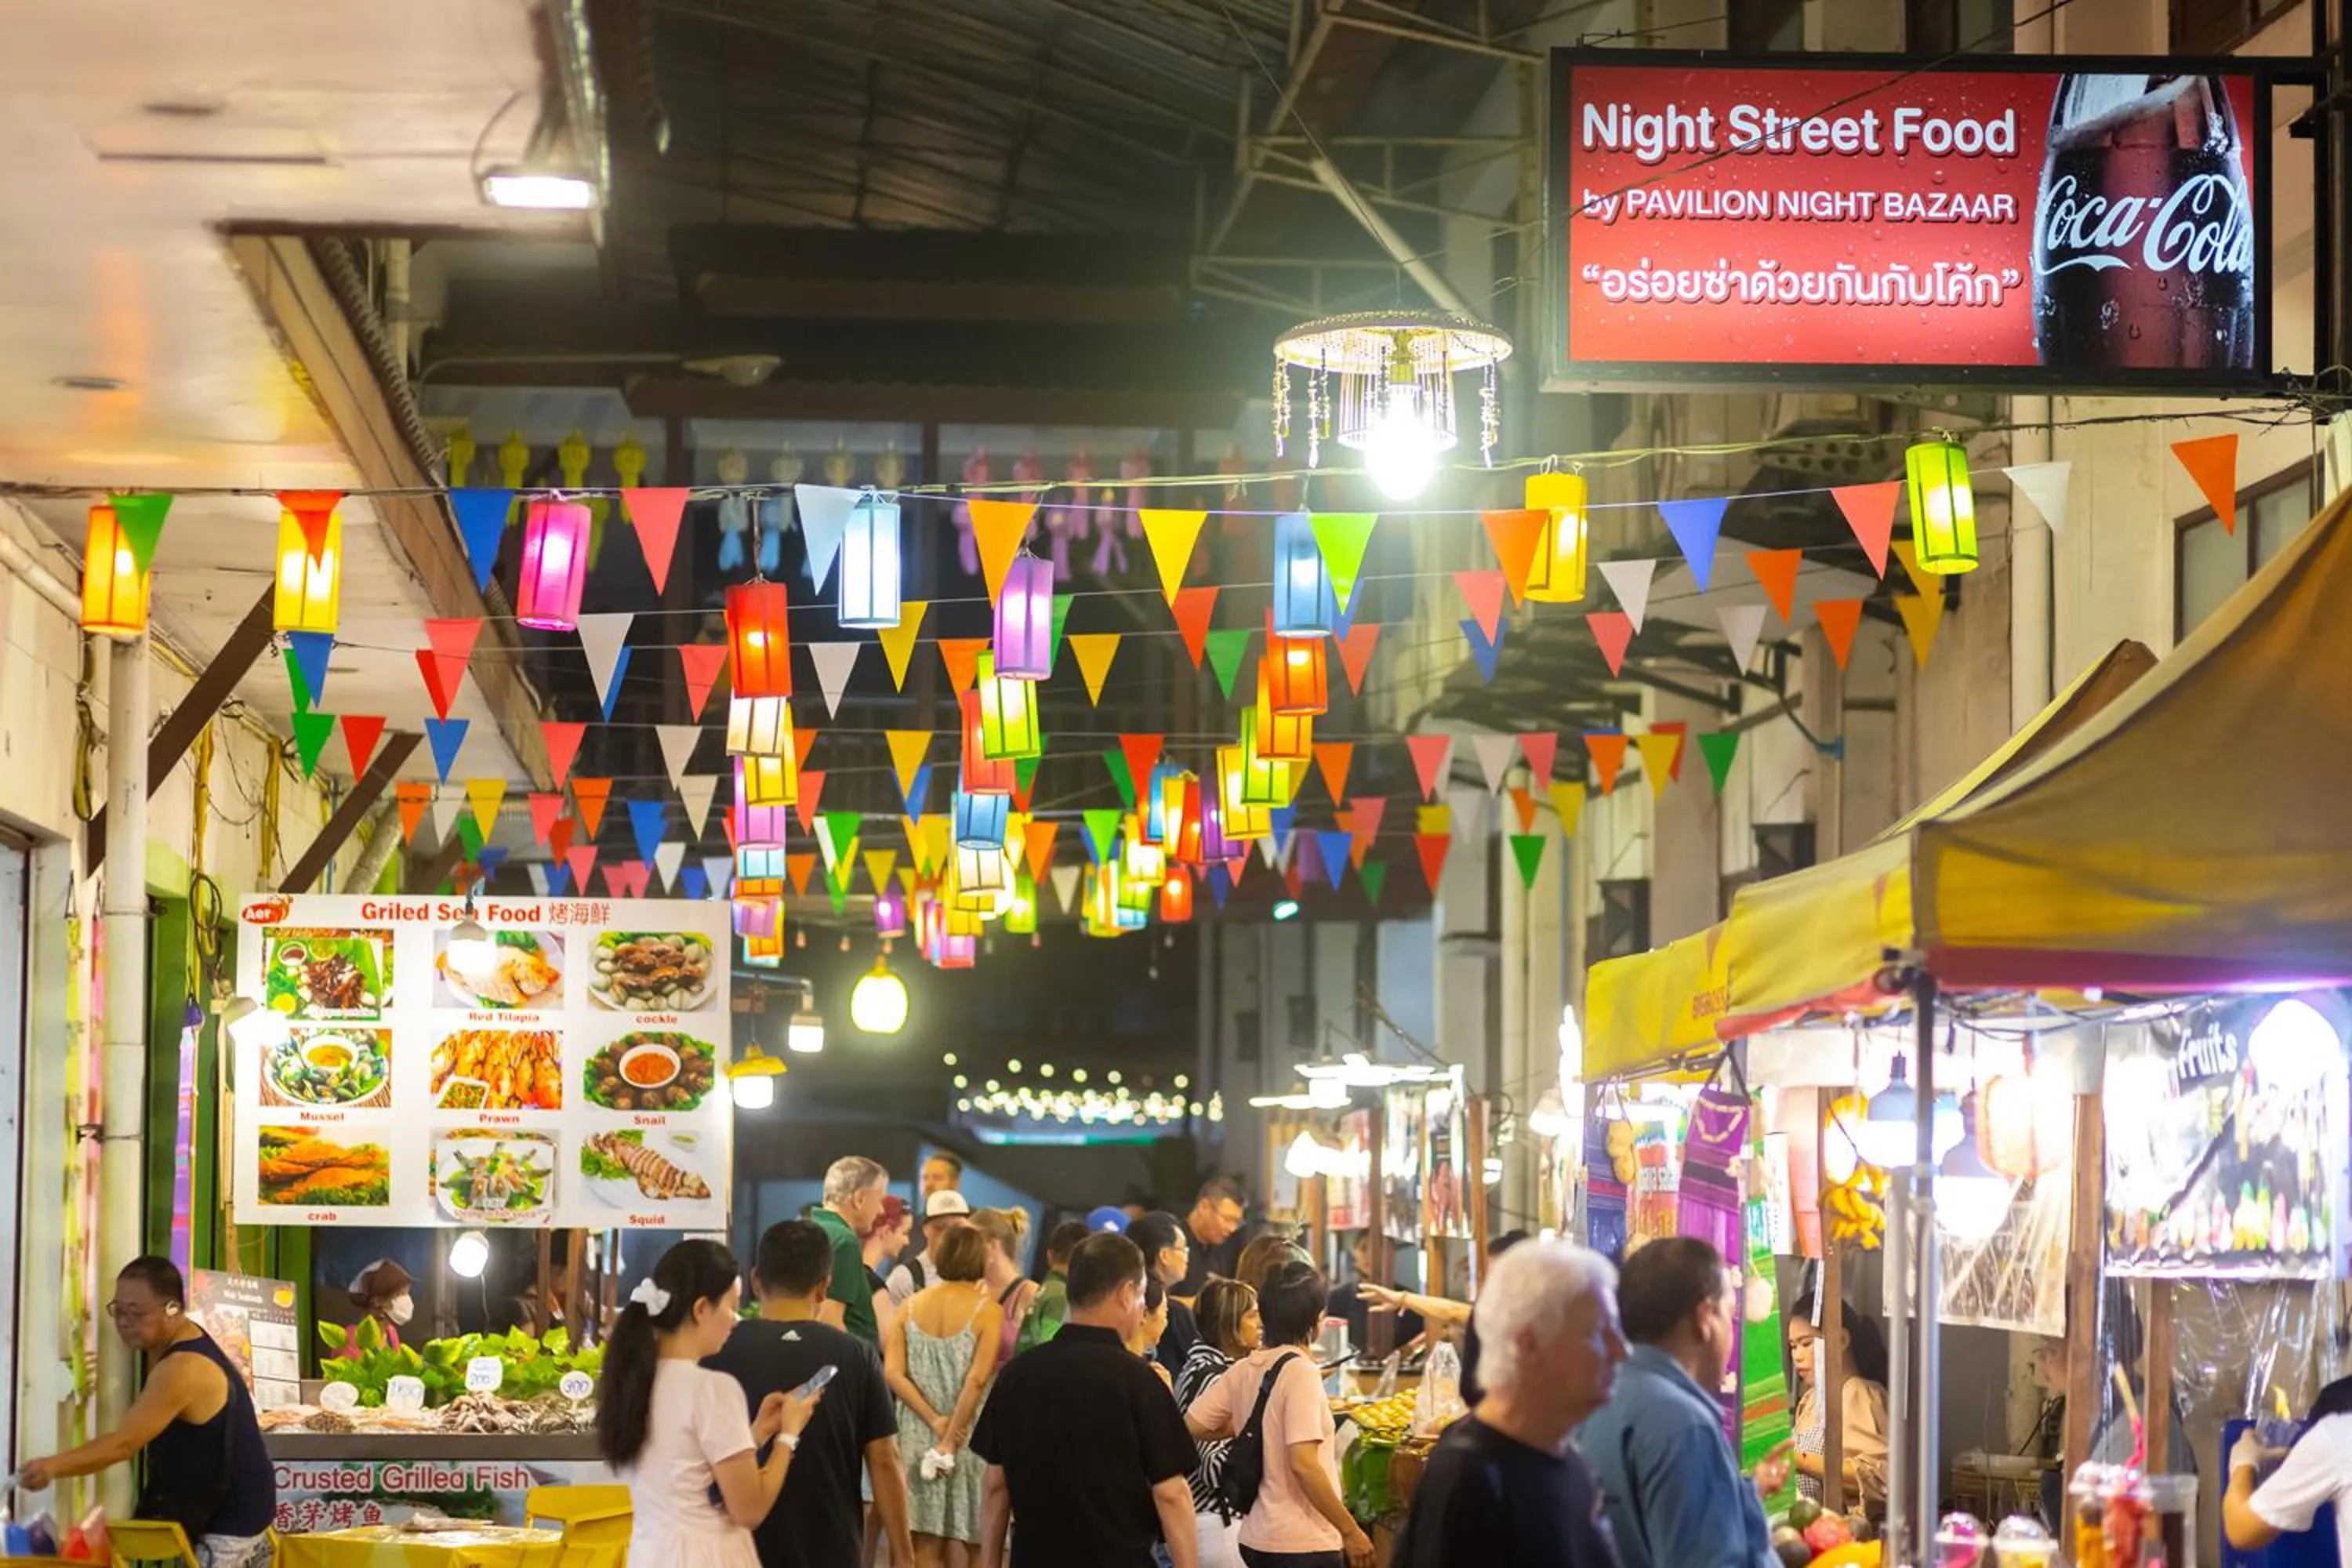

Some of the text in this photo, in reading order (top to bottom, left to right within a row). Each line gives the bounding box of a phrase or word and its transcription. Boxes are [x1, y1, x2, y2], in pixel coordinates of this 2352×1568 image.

[1582, 103, 2016, 160] Night Street Food
[1583, 188, 2014, 220] by PAVILION NIGHT BAZAAR
[2034, 173, 2253, 275] Coca-Cola
[361, 902, 429, 921] Griled
[488, 902, 541, 921] Food
[636, 1014, 678, 1024] cockle
[299, 1112, 345, 1121] Mussel
[479, 1114, 521, 1123] Prawn
[633, 1115, 666, 1125] Snail
[307, 1211, 337, 1221] crab
[629, 1214, 666, 1225] Squid
[274, 1466, 371, 1488] Crusted
[477, 1466, 528, 1488] Fish
